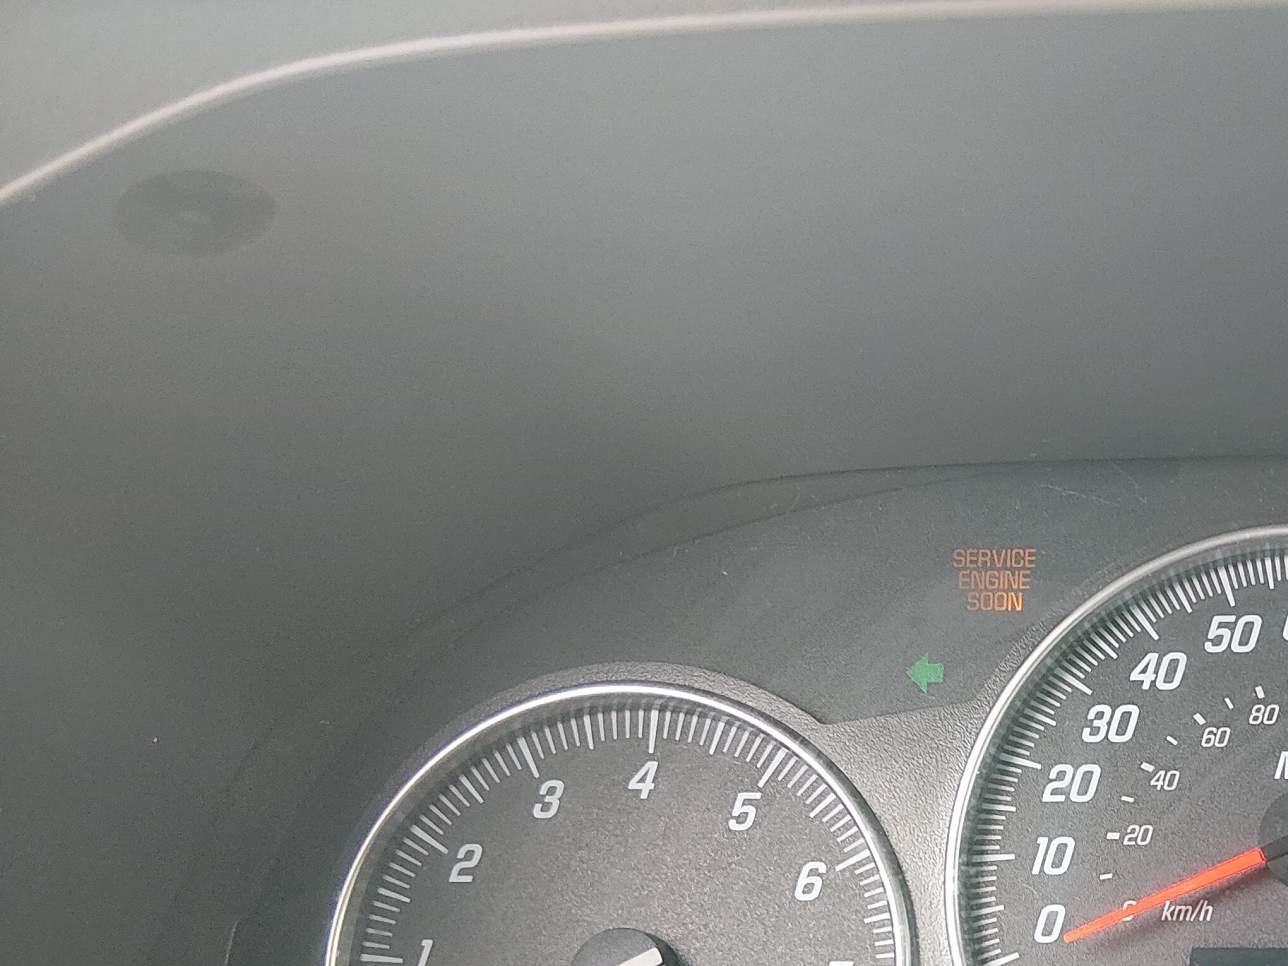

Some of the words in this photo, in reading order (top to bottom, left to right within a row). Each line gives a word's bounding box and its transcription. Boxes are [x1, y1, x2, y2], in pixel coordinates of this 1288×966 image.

[953, 548, 1037, 568] SERVICE
[959, 570, 1031, 589] ENGINE
[967, 591, 1024, 611] SOON
[1205, 615, 1262, 652] 50
[1130, 653, 1186, 690] 40
[1082, 705, 1139, 742] 30
[1249, 705, 1279, 724] 80
[1201, 727, 1230, 747] 60
[628, 762, 658, 799] 4
[1042, 765, 1101, 802] 20
[1151, 769, 1180, 790] 40
[533, 780, 565, 819] 3
[729, 793, 761, 831] 5
[1124, 825, 1153, 845] 20
[448, 844, 483, 883] 2
[1032, 837, 1075, 875] 10
[795, 862, 827, 901] 6
[1034, 905, 1065, 943] 0
[1162, 901, 1212, 921] km/h
